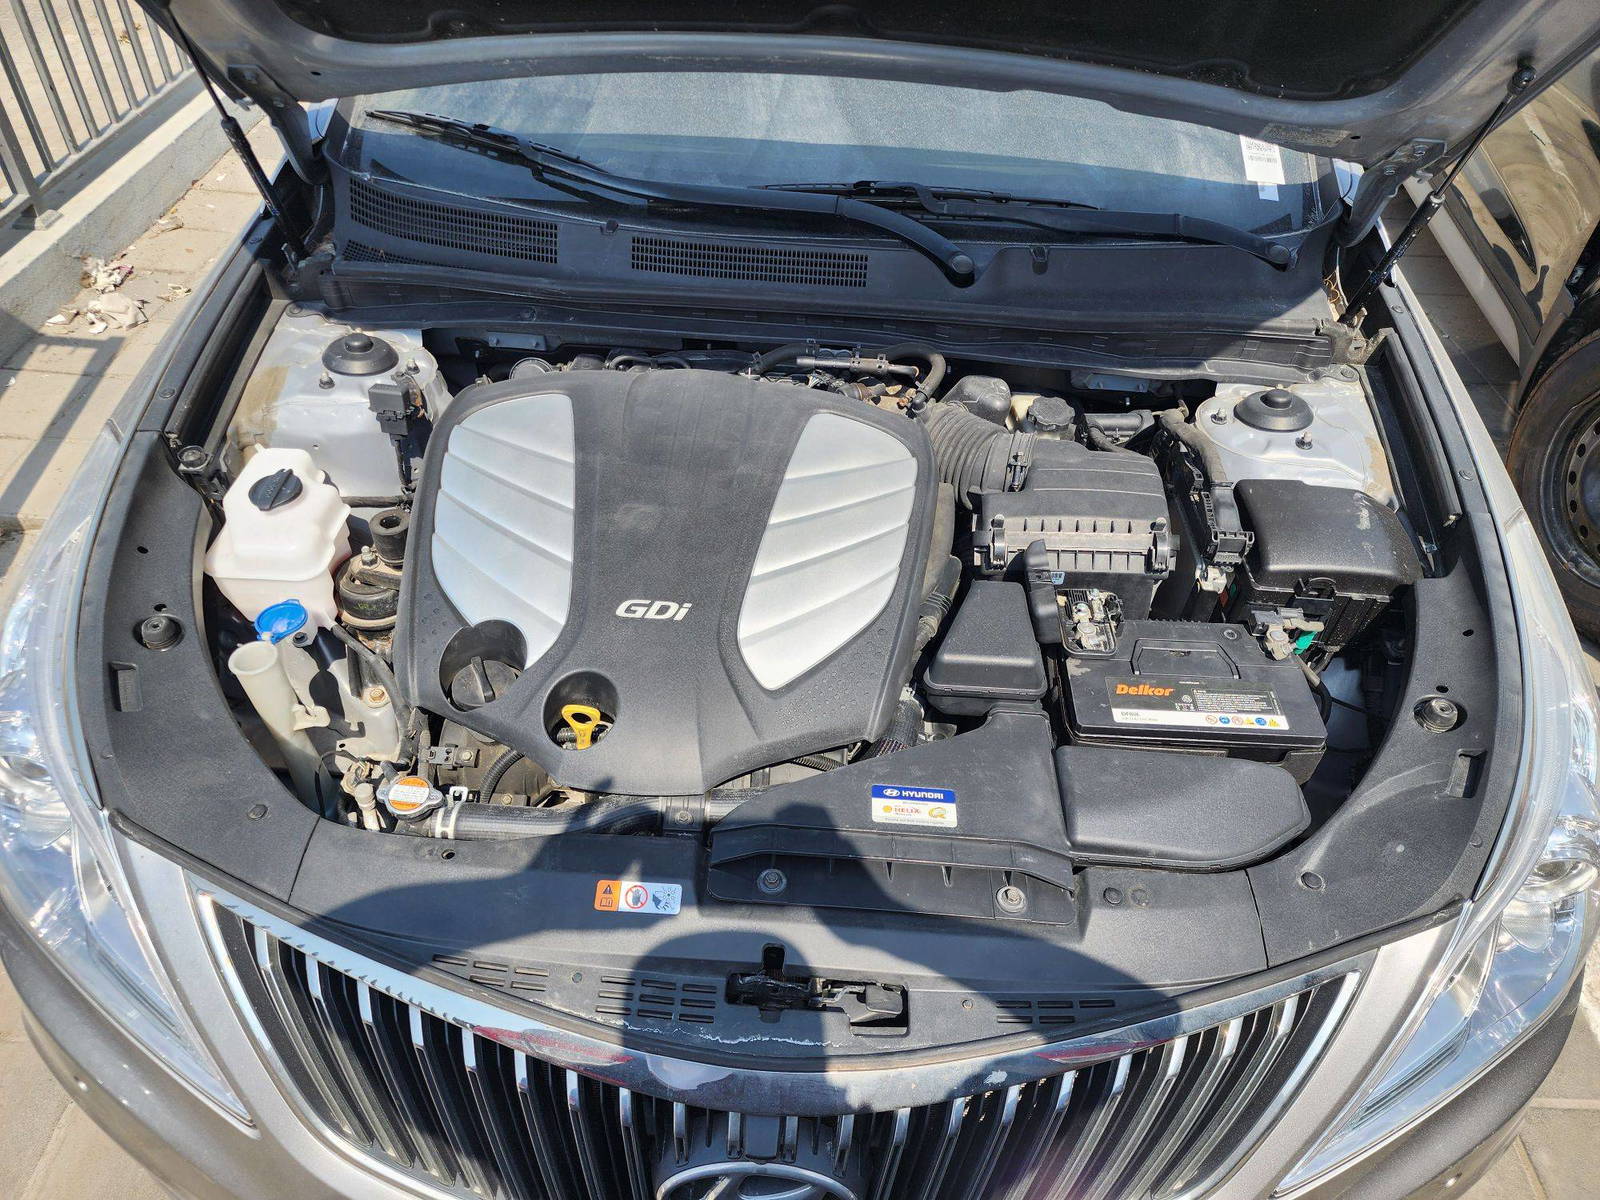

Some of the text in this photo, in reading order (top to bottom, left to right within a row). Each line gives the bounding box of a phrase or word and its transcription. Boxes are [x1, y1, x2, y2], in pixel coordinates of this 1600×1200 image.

[615, 599, 692, 621] GDi
[1115, 683, 1174, 697] Delkor
[902, 790, 944, 799] HYUNDAI
